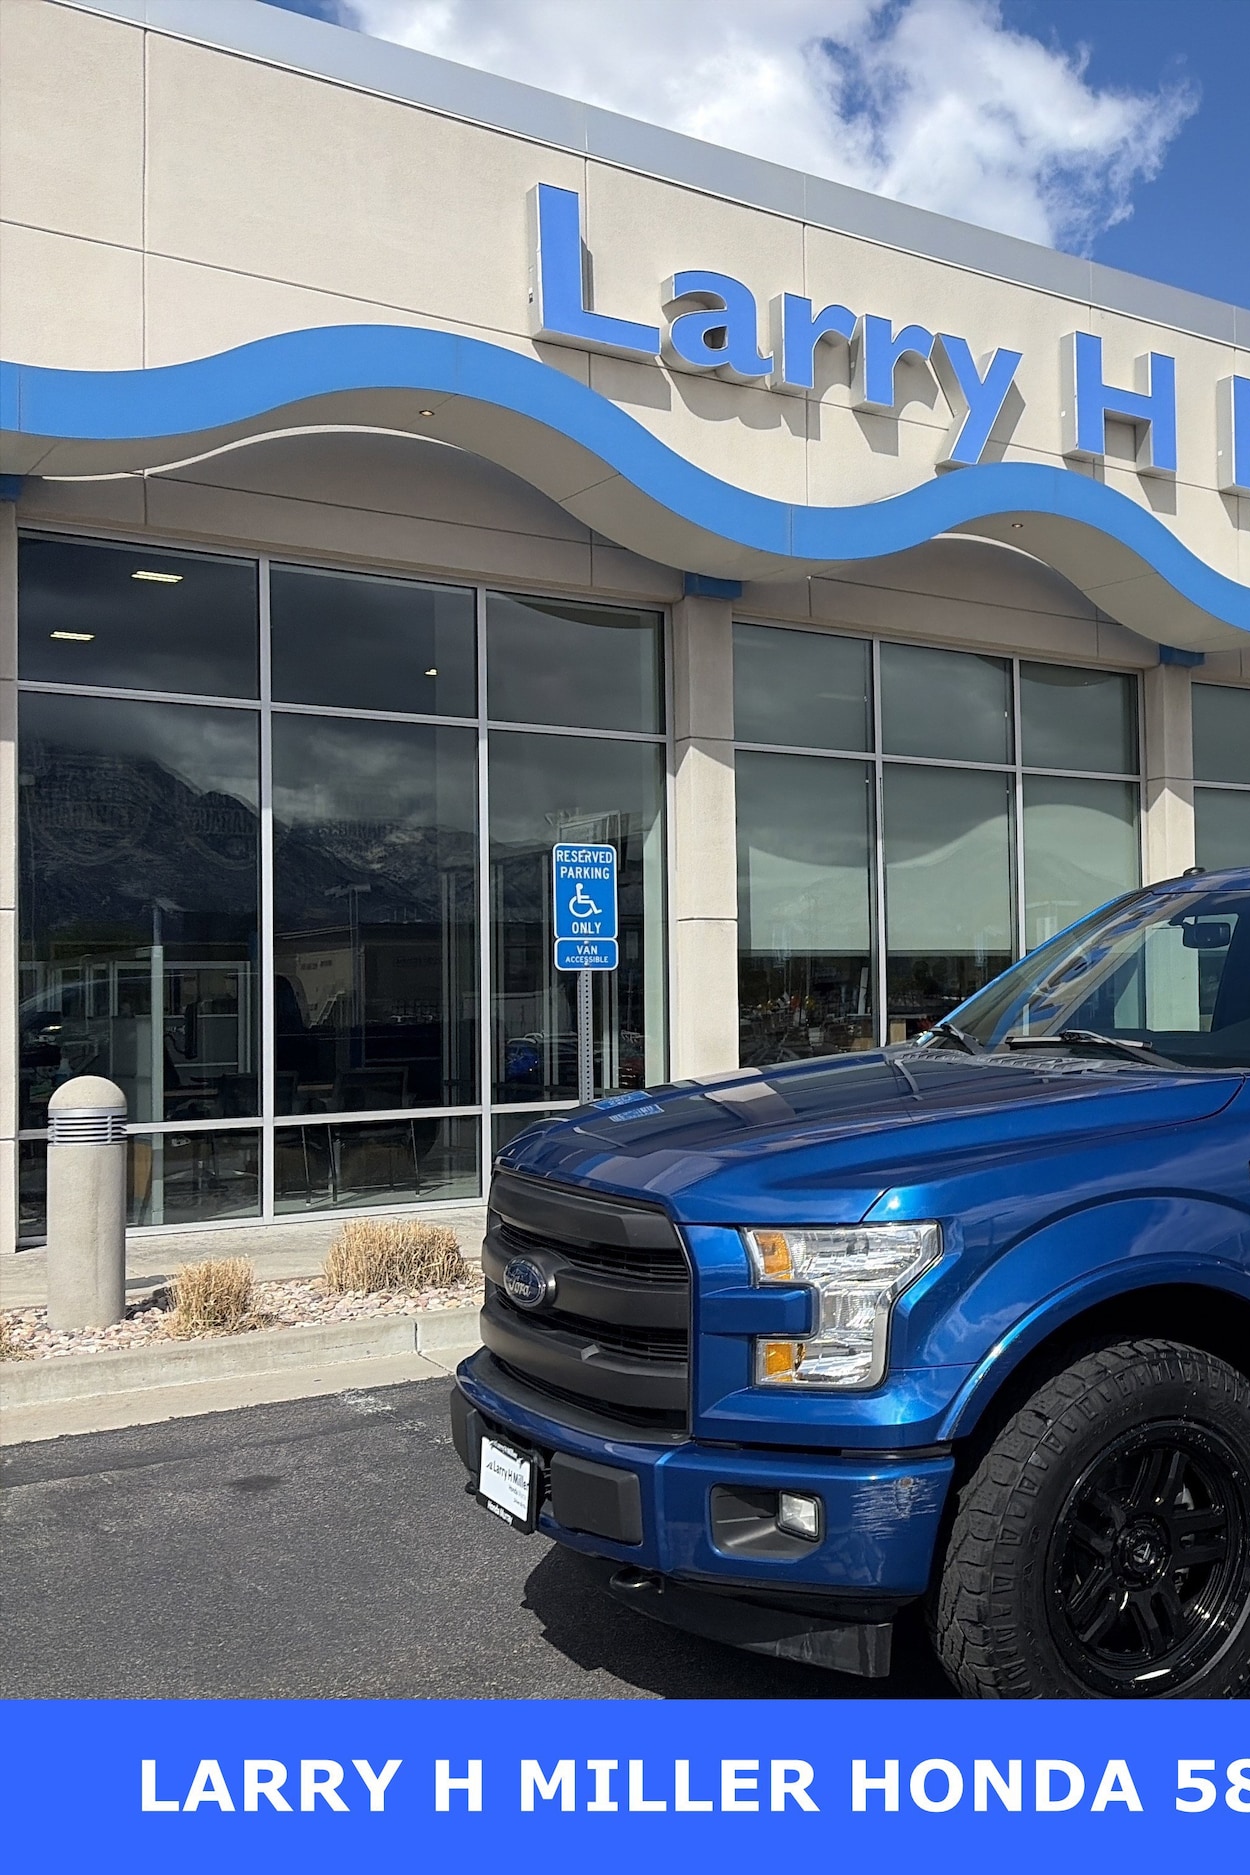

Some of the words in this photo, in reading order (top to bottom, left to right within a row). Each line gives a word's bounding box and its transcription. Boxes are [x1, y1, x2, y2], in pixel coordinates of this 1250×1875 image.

[528, 182, 1023, 465] Larry
[1061, 331, 1177, 476] H
[556, 850, 613, 863] RESERVED
[560, 867, 610, 879] PARKING
[571, 922, 601, 934] ONLY
[576, 945, 598, 955] VAN
[565, 956, 609, 964] ACCESSIBLE
[506, 1270, 532, 1298] Ford
[493, 1460, 507, 1481] Larry
